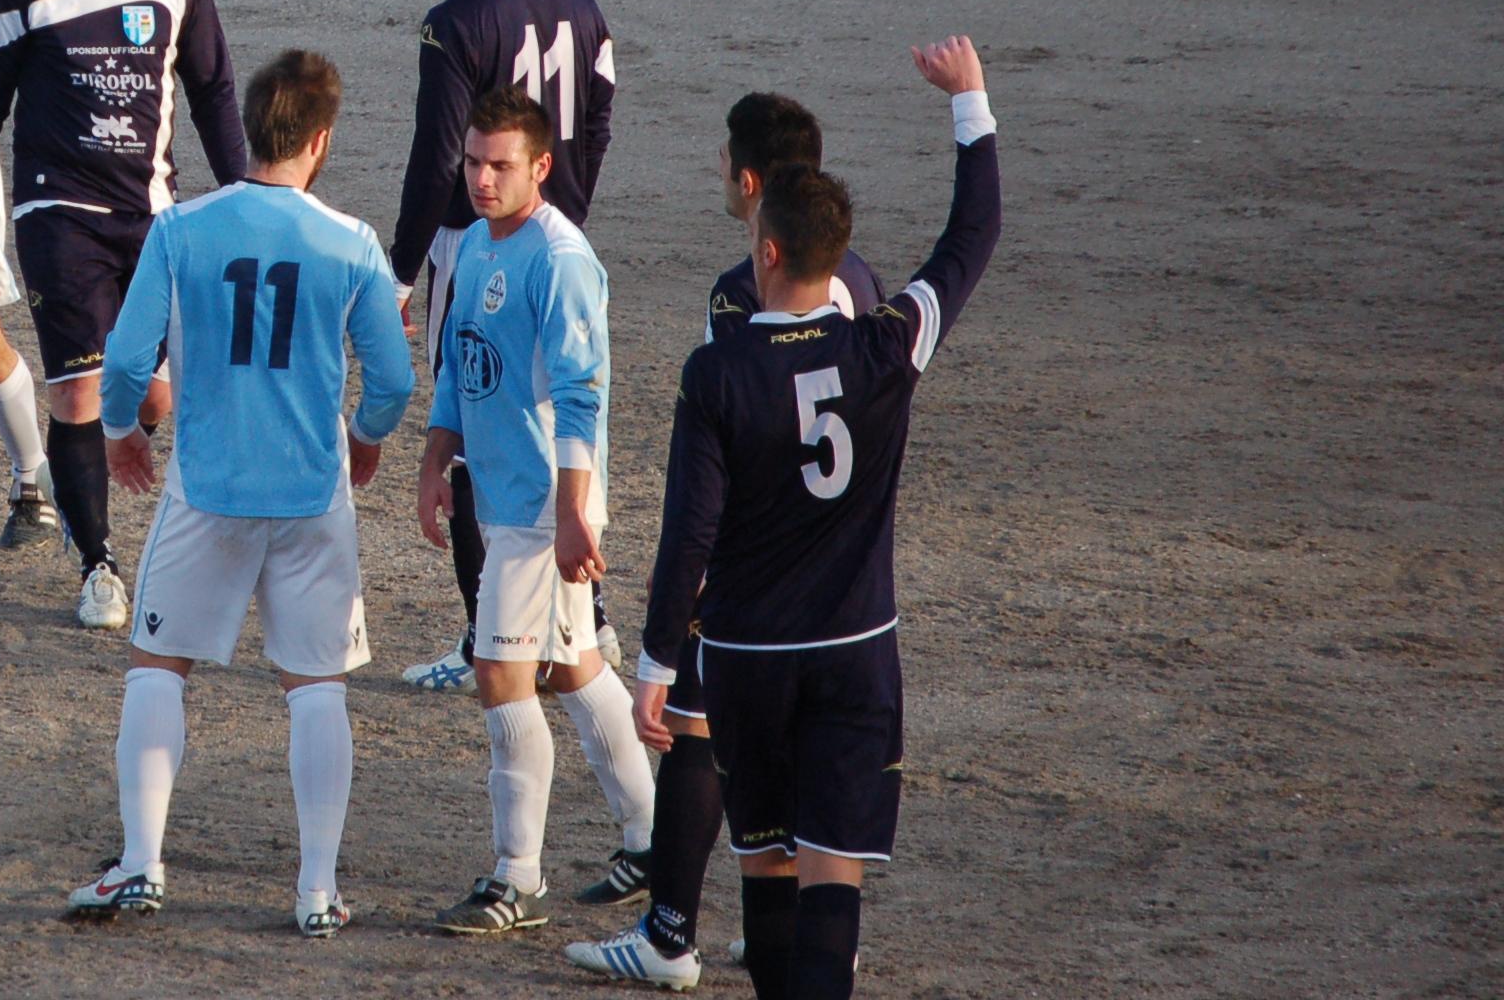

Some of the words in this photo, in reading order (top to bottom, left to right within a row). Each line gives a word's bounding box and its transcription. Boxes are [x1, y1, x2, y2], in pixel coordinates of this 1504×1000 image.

[66, 46, 109, 56] SPONSOR
[110, 46, 156, 56] UFFICIALE
[513, 20, 575, 141] 11
[222, 257, 301, 371] 11
[770, 327, 829, 344] ROYAL
[794, 366, 853, 500] 5
[492, 634, 538, 646] macron
